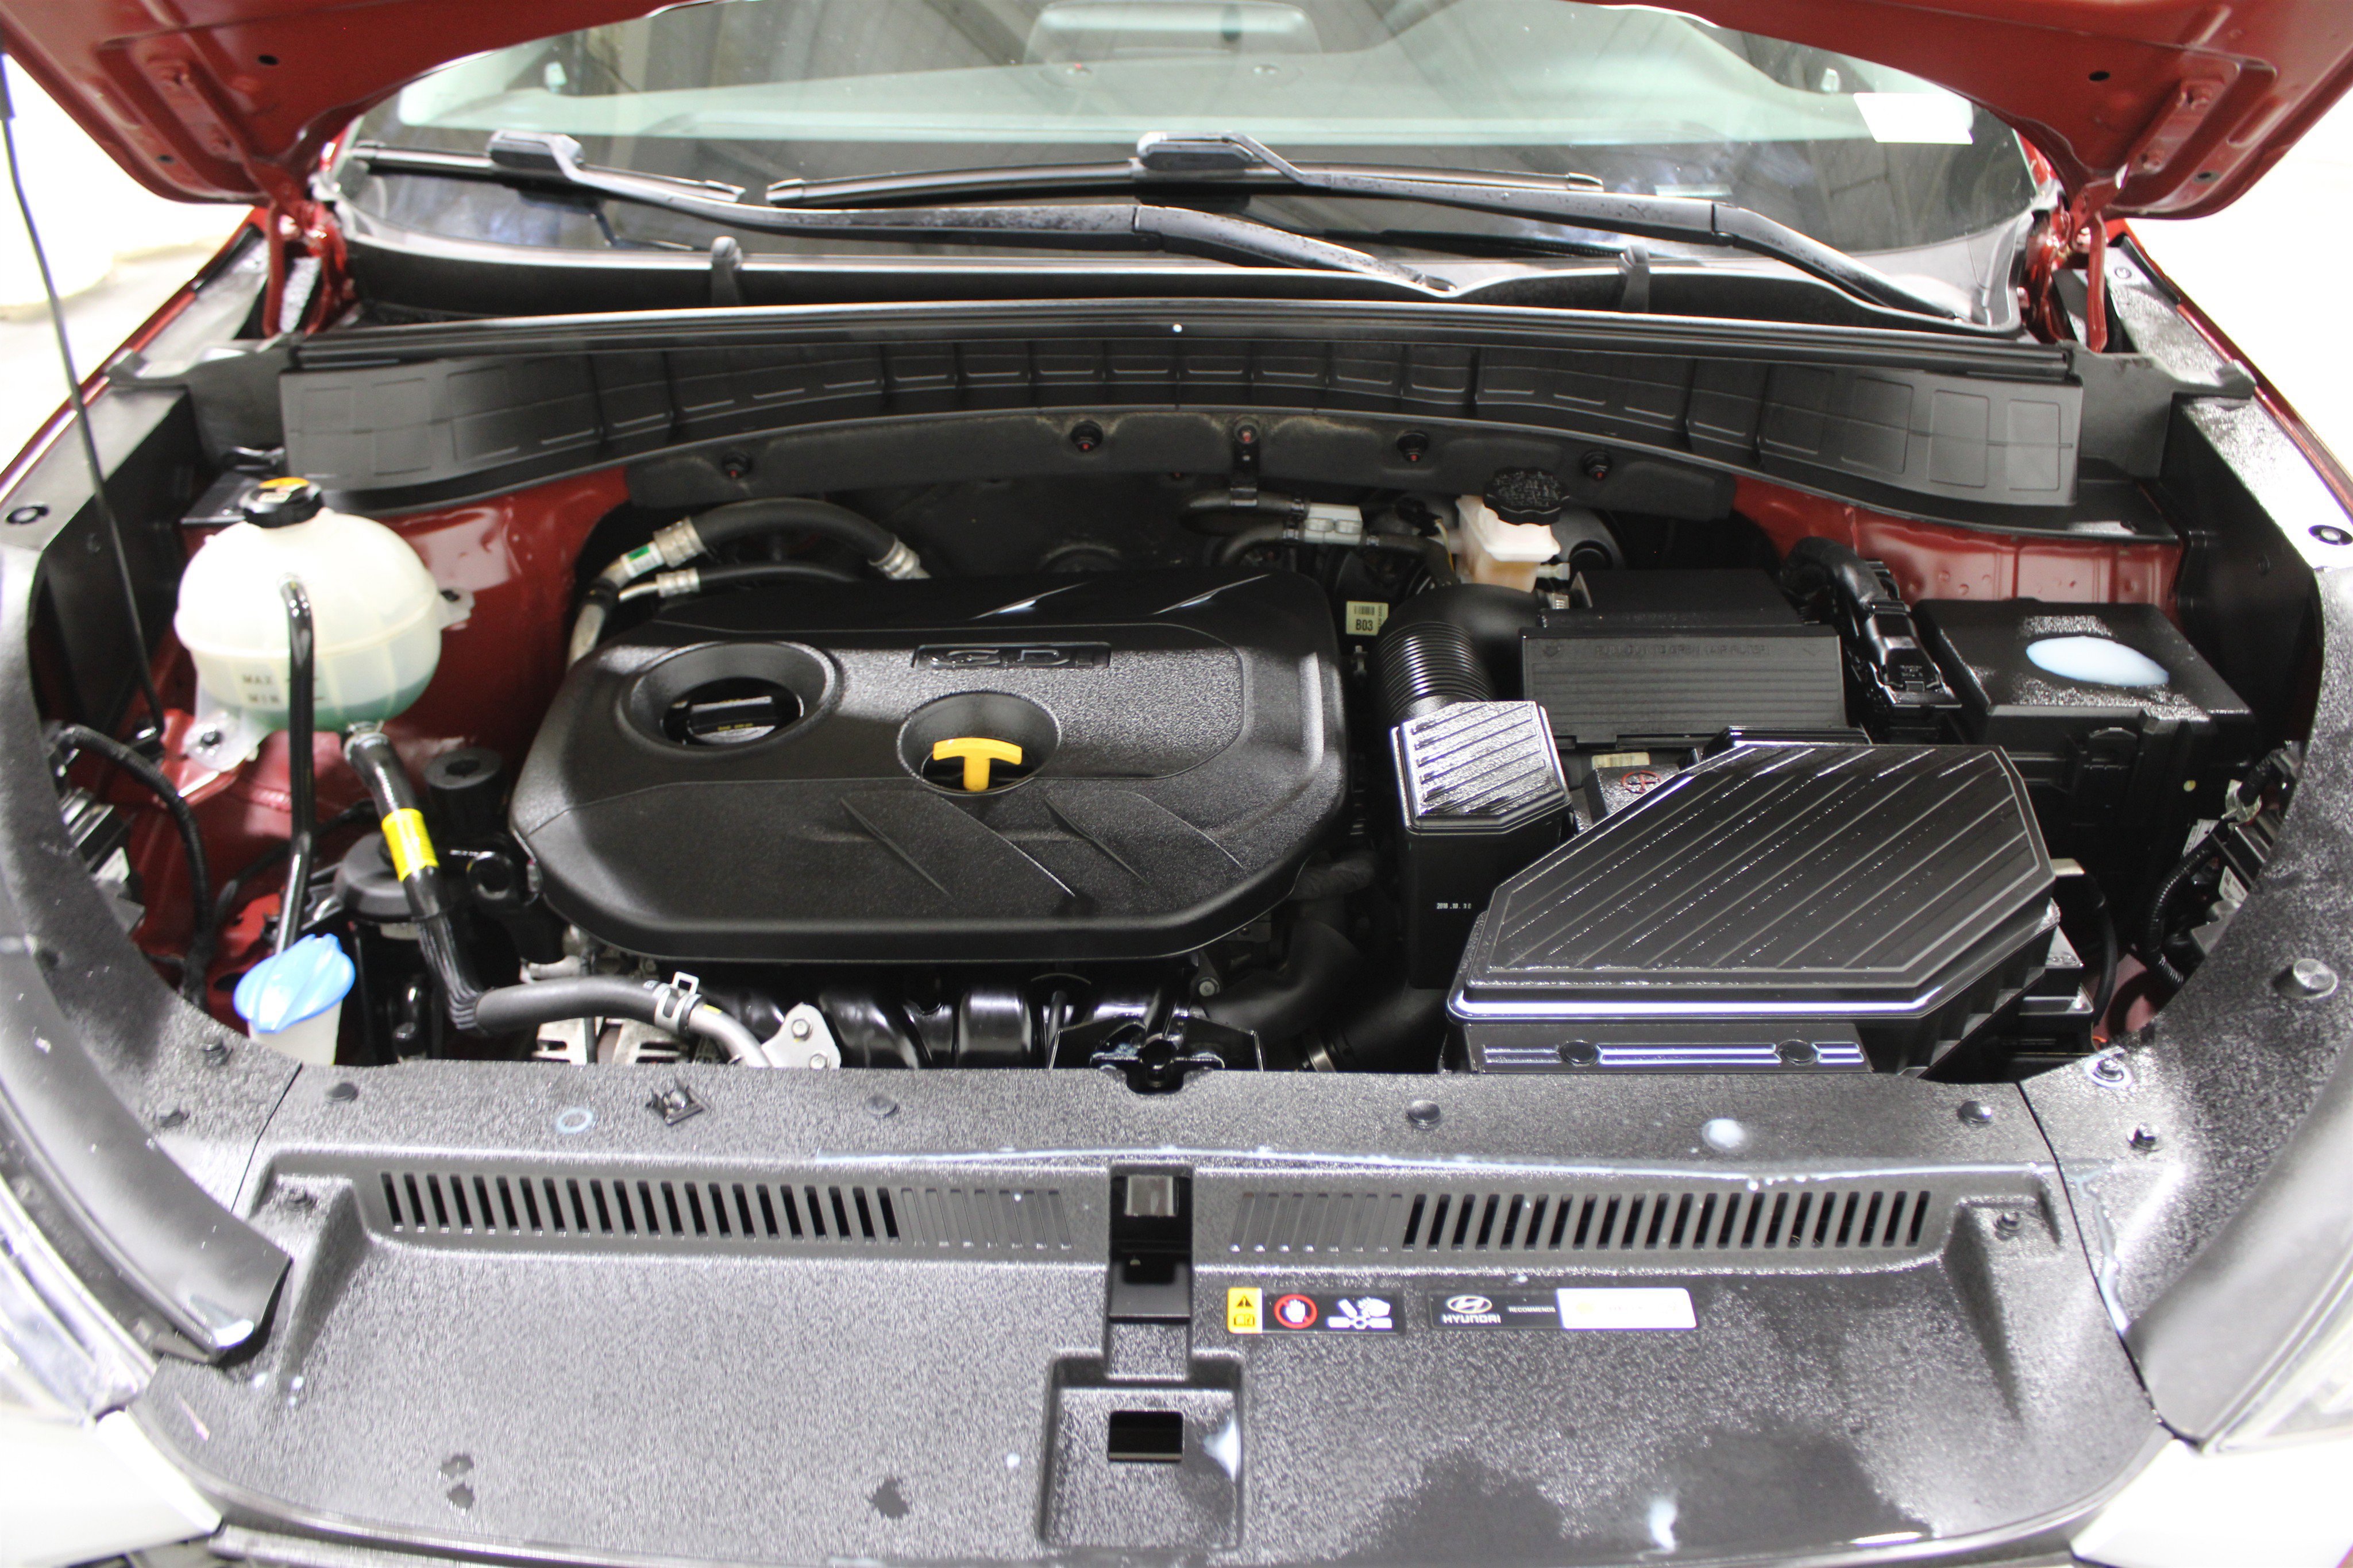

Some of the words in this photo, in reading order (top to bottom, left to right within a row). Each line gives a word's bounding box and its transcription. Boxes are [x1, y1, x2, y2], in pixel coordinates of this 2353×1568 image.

[241, 674, 273, 685] MAX
[248, 694, 279, 704] MIN
[1442, 1313, 1502, 1324] HYUNDAI
[1507, 1305, 1556, 1313] RECOMMENDS
